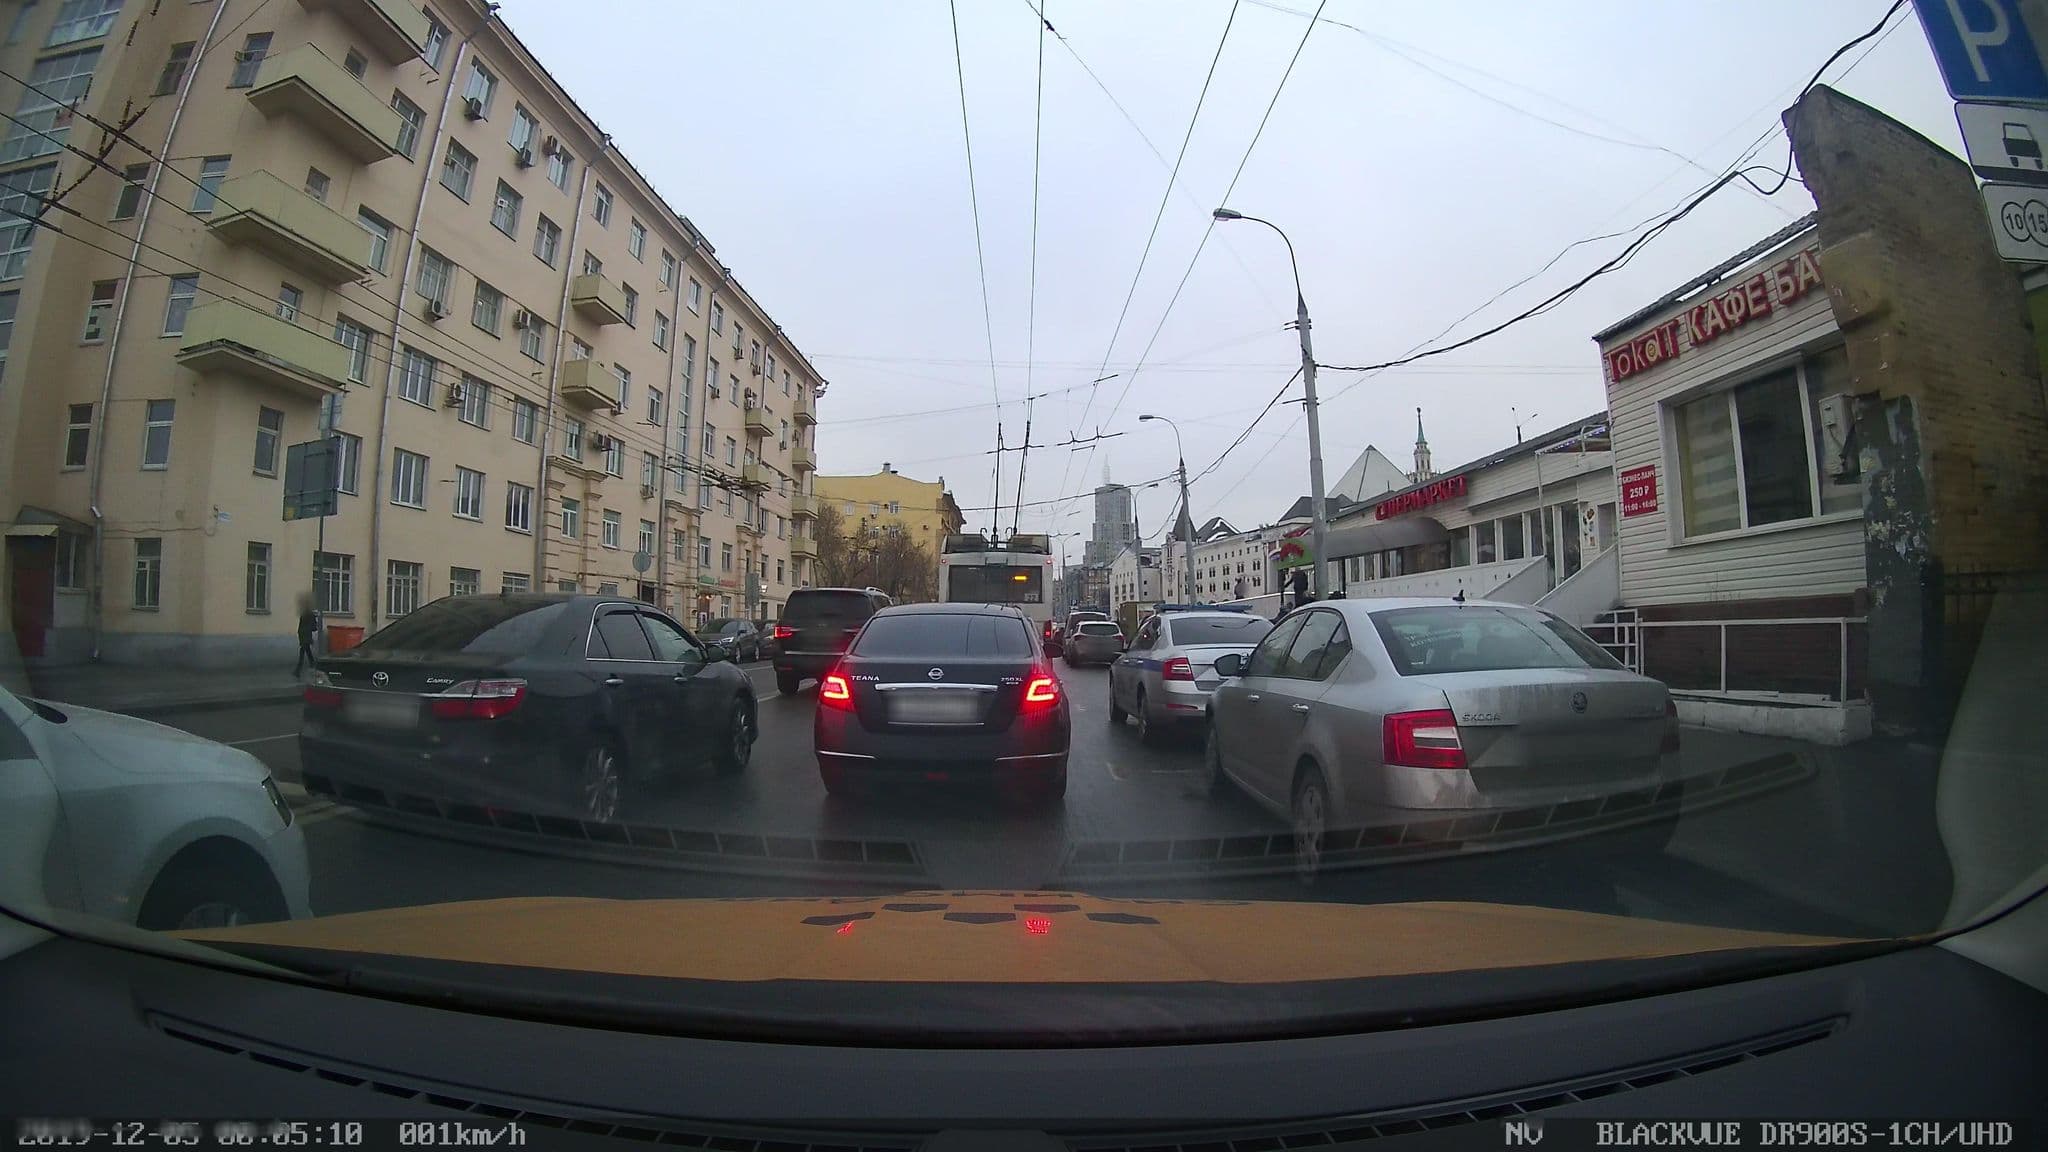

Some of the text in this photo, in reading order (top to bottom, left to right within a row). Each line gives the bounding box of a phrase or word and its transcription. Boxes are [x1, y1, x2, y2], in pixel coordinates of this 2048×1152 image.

[2005, 212, 2024, 231] 10
[1685, 274, 1769, 345] КАФЕ
[1773, 250, 1822, 303] БА
[1630, 486, 1643, 499] 250
